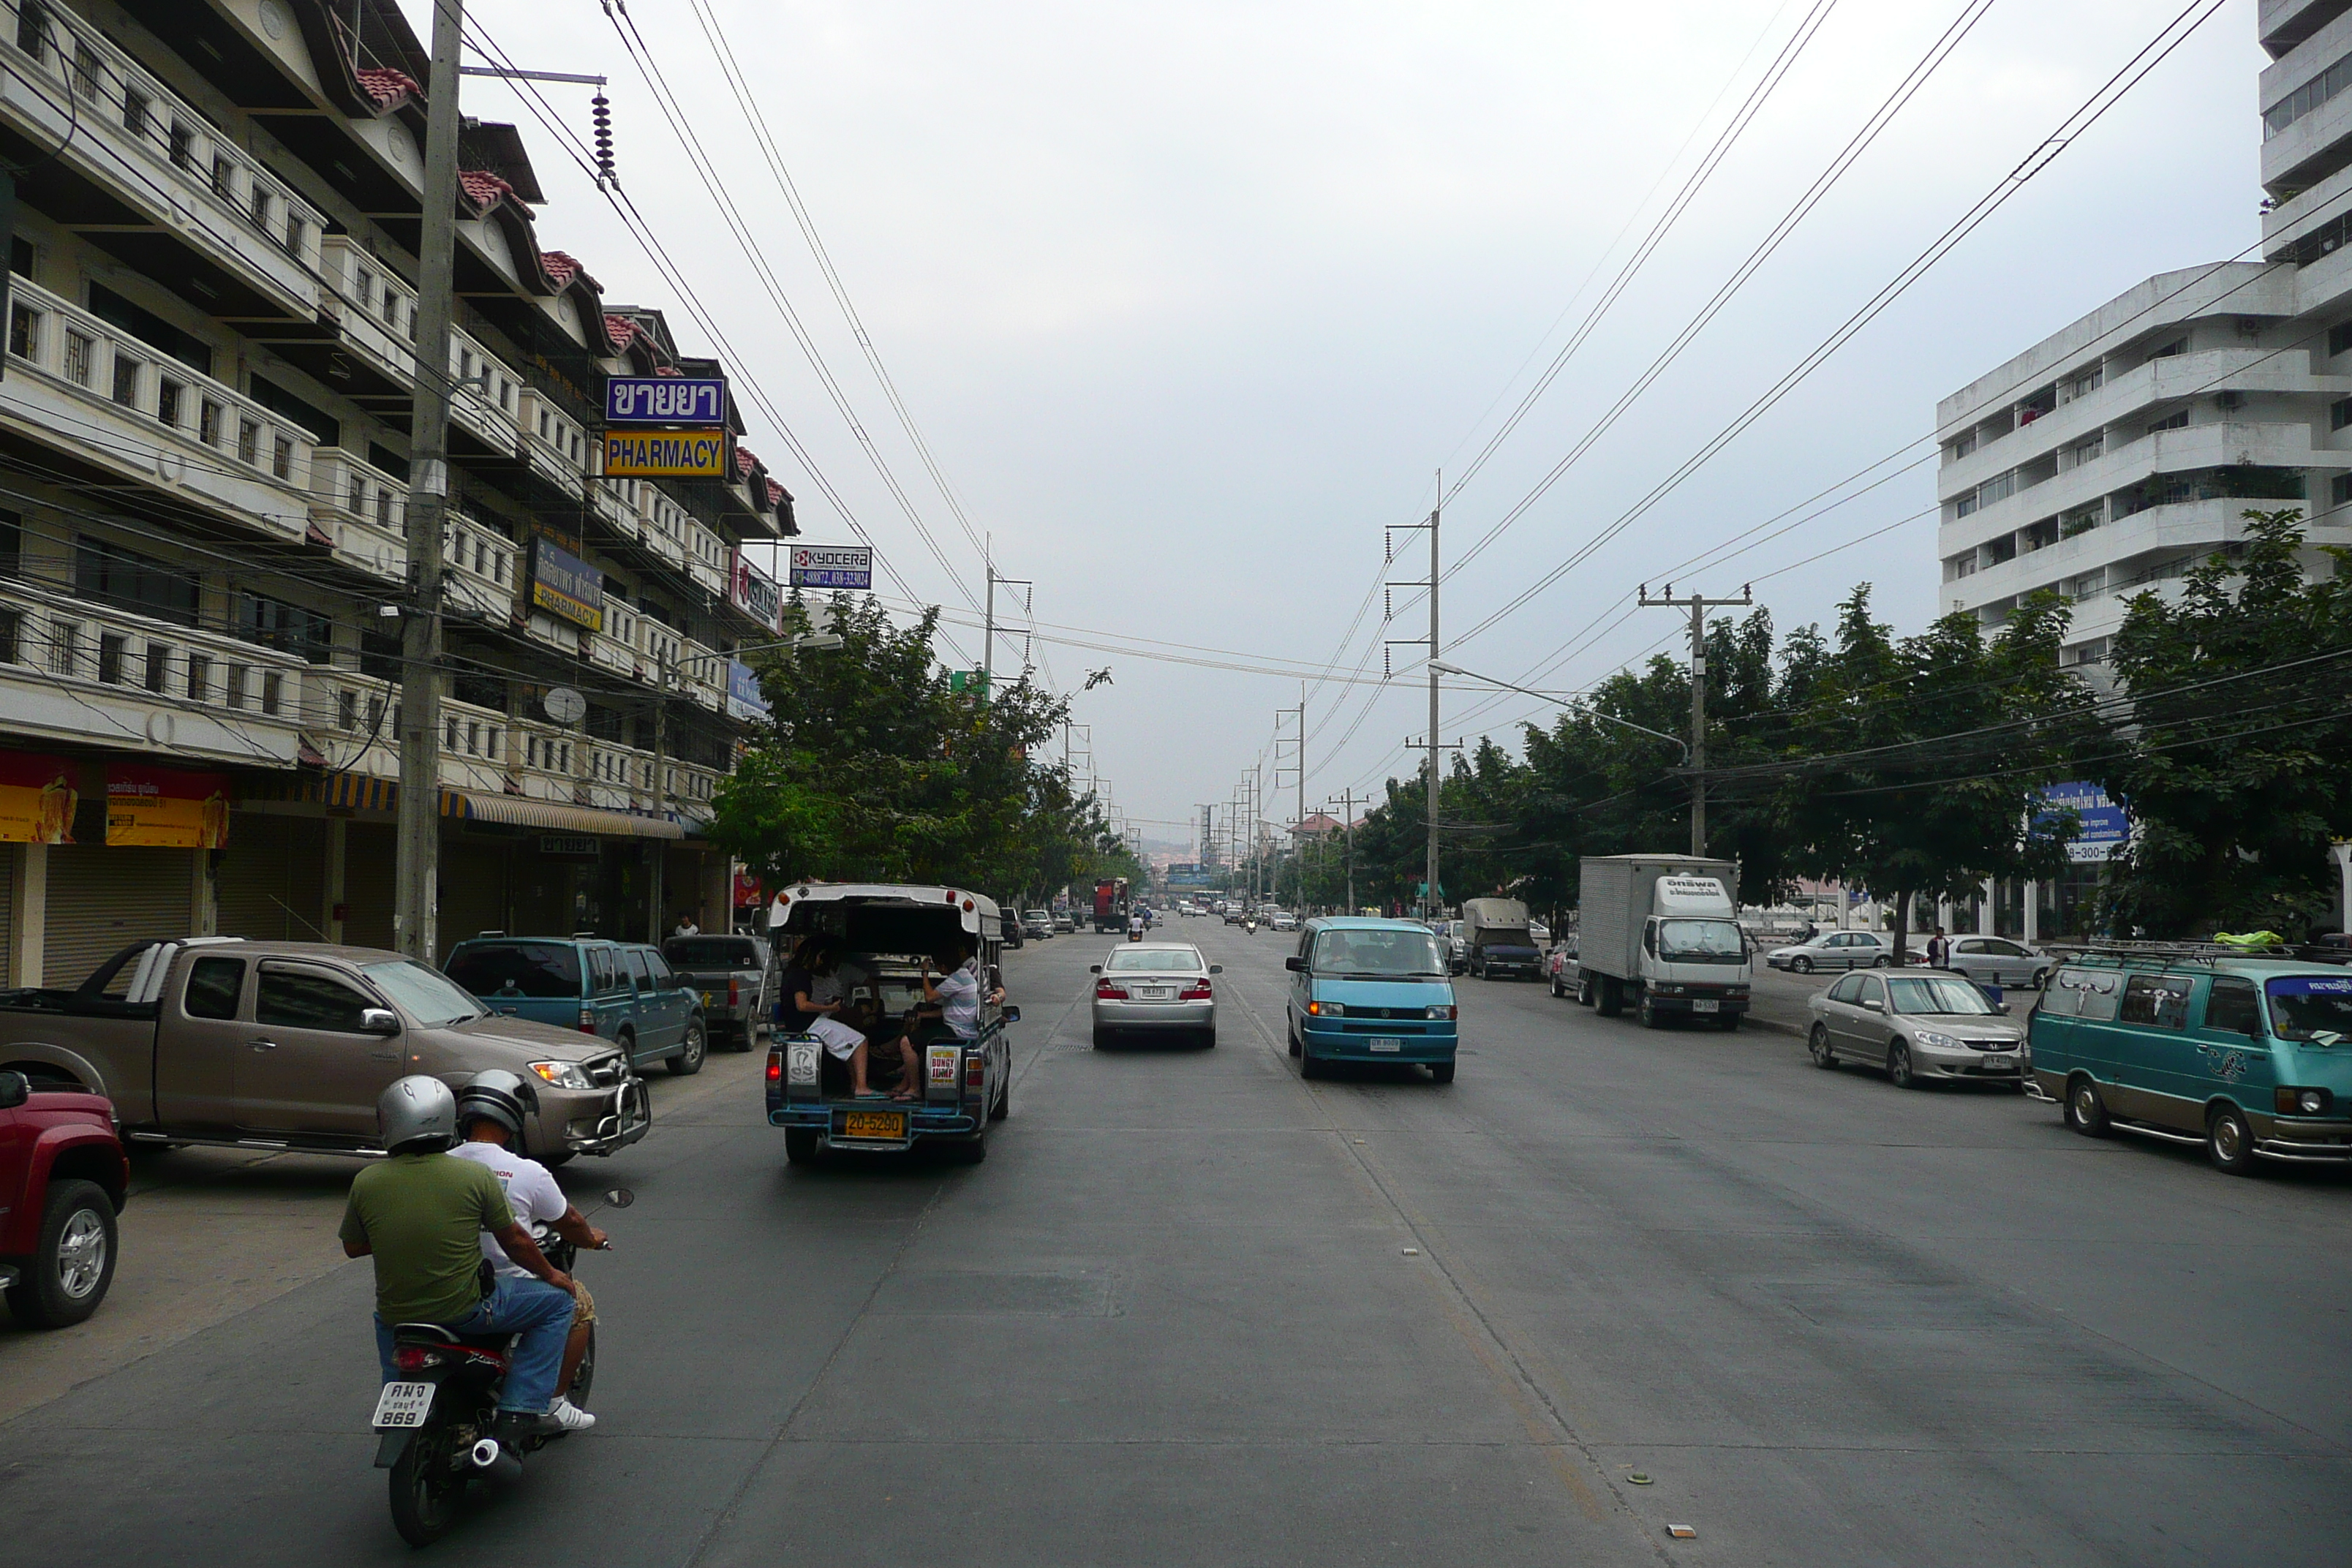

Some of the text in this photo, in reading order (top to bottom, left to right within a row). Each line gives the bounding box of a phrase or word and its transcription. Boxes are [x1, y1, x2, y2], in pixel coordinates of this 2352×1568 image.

[614, 384, 717, 416] ขายยา
[608, 439, 720, 468] PHARMACY
[541, 589, 596, 625] PHARMACY
[932, 1058, 954, 1068] BUNGY
[848, 1113, 900, 1132] 20-5290
[382, 1411, 417, 1425] 869
